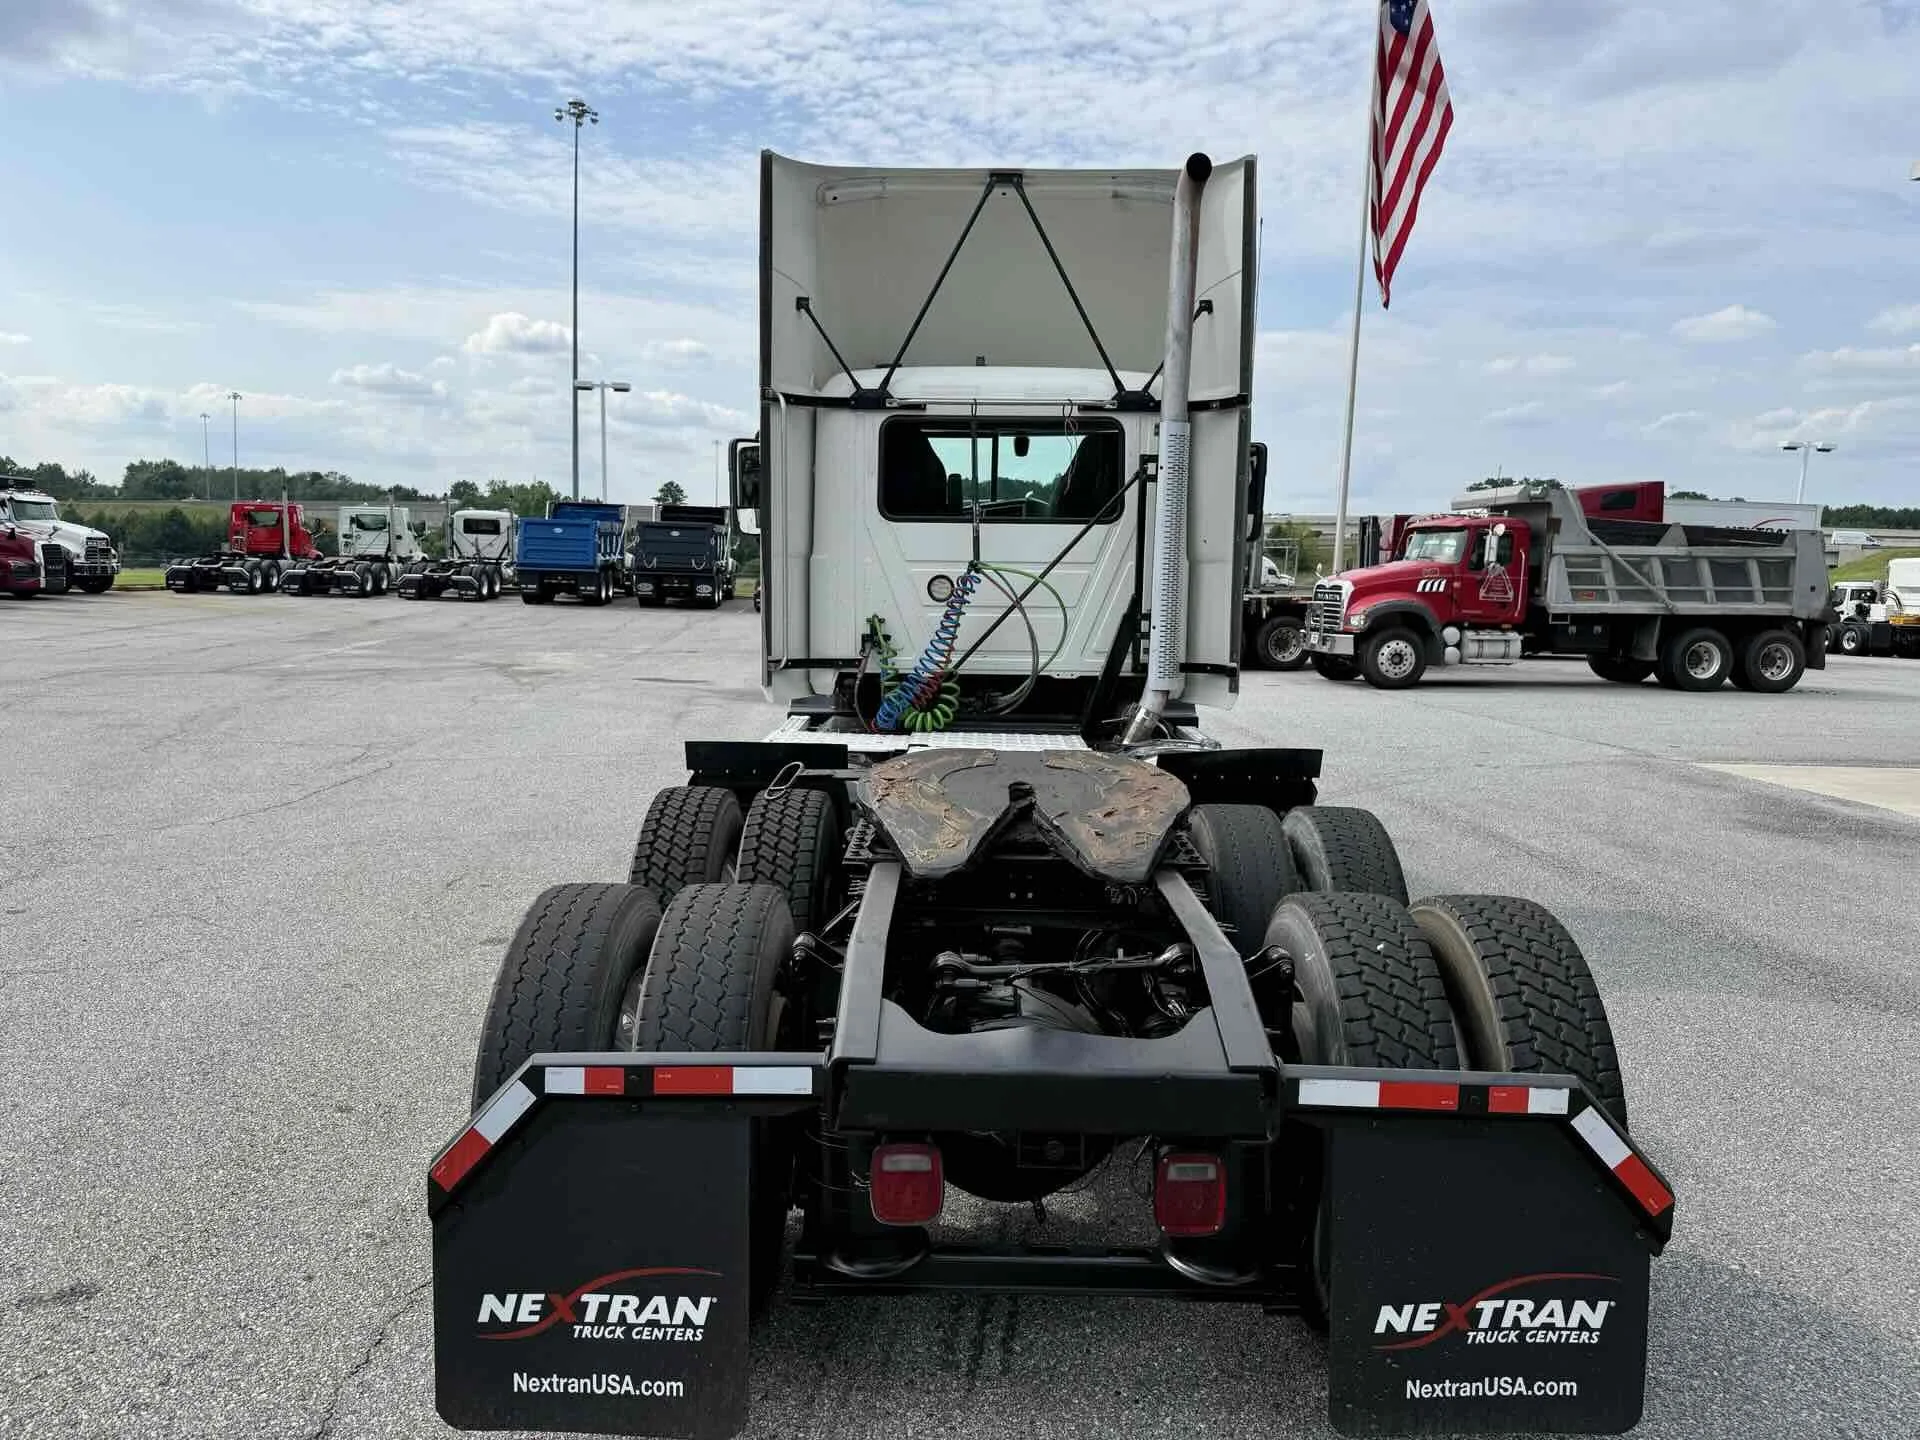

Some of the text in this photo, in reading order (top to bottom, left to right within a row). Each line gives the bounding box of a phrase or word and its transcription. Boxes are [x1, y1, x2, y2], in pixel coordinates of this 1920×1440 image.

[477, 1292, 712, 1326] NEXTRAN
[1374, 1299, 1610, 1334] NEXTRAN
[572, 1326, 704, 1341] TRUCK CENTERS
[1466, 1329, 1600, 1345] TRUCK CENTERS
[512, 1372, 684, 1397] NextranUSA.com
[1405, 1376, 1577, 1400] NextranUSA.com
